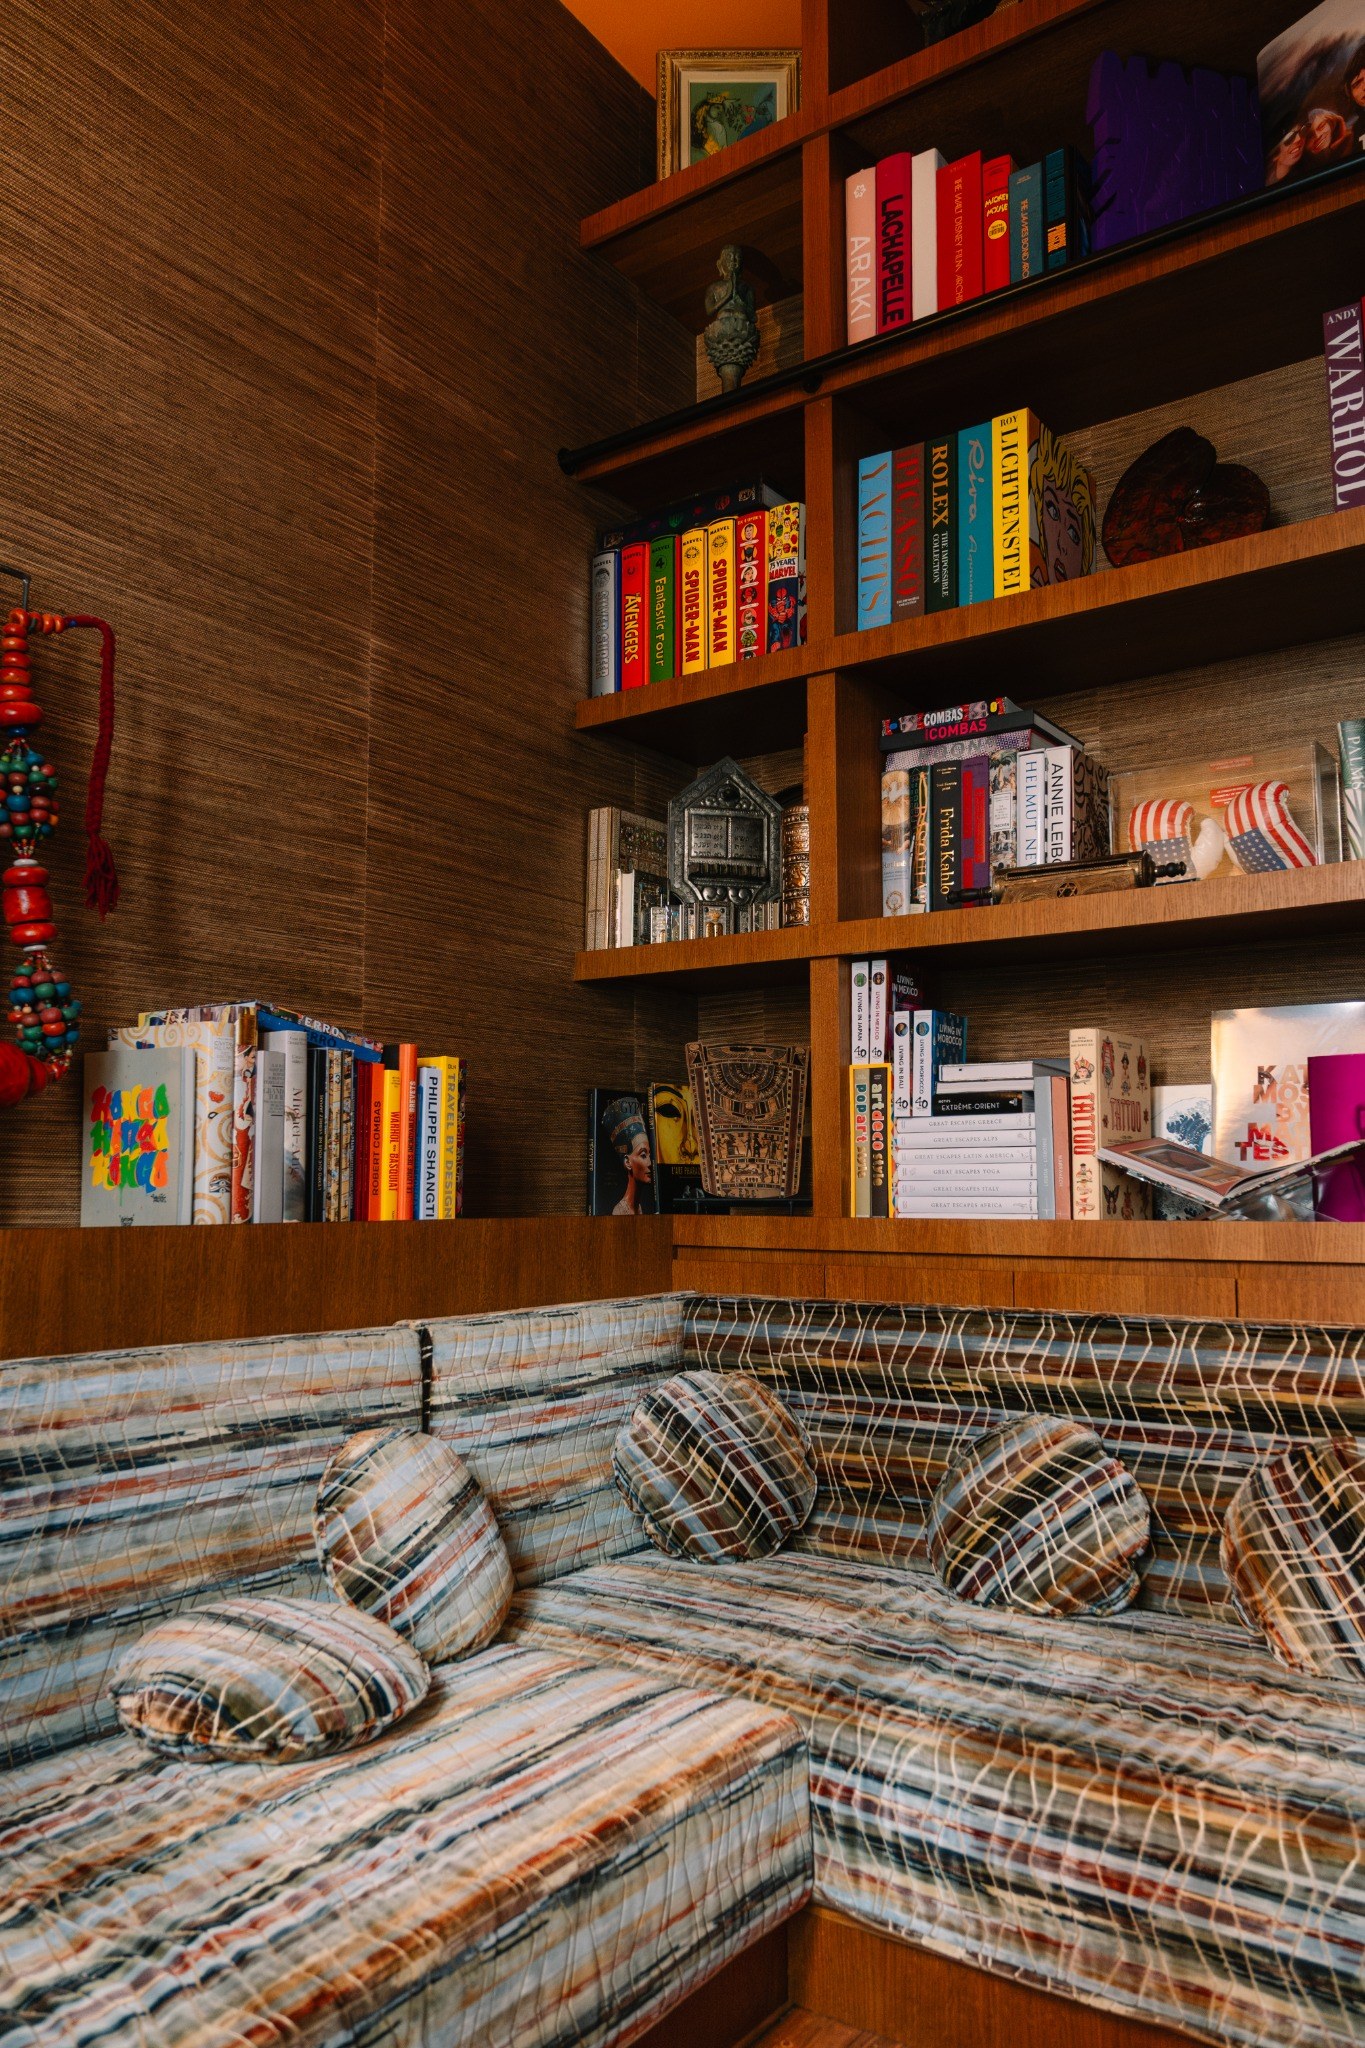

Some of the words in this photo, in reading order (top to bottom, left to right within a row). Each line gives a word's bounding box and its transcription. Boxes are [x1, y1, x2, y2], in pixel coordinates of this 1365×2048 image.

[954, 193, 963, 214] WALT
[984, 193, 1009, 208] MICKEY
[954, 215, 963, 247] DISNEY
[1021, 237, 1029, 261] BOND
[880, 193, 905, 328] LACHAPELLE
[850, 235, 871, 325] ARAKI
[1326, 306, 1360, 326] ANDY
[1000, 414, 1018, 427] ROY
[1326, 319, 1365, 506] WARHOL
[931, 443, 949, 529] ROLEX
[968, 438, 985, 524] Riva
[1000, 427, 1021, 593] LICHTENSTEI
[682, 537, 703, 547] MARVEL
[709, 525, 731, 536] MARVEL
[860, 461, 888, 612] YACHTS
[941, 530, 949, 548] THE
[654, 557, 665, 570] 4
[769, 560, 776, 571] 75
[776, 557, 796, 568] YEARS
[769, 566, 796, 580] MARVEL
[932, 533, 940, 584] COLLECTION
[941, 550, 949, 598] IMPOSSIBLE
[654, 576, 667, 631] Fantastic
[684, 569, 700, 663] SPIDER-MAN
[712, 558, 728, 654] SPIDER-MAN
[624, 592, 642, 665] AVENGERS
[923, 707, 964, 727] COMBAS
[1025, 760, 1037, 831] HELMUT
[1051, 763, 1064, 817] ANNIE
[940, 807, 954, 848] Frida
[940, 849, 955, 895] Kahlo
[892, 983, 898, 992] IN
[898, 985, 919, 997] MEXICO
[896, 974, 914, 986] LIVING
[937, 1033, 963, 1047] MOROCCO
[939, 1023, 955, 1037] LIVING
[853, 1046, 867, 1058] 40
[871, 1046, 883, 1058] 40
[1257, 1064, 1309, 1084] KAT
[409, 1080, 417, 1113] BREVETS
[427, 1075, 439, 1144] PHILIPPE
[446, 1073, 456, 1130] TRAVEL
[895, 1097, 909, 1109] 40
[915, 1096, 929, 1109] 40
[372, 1100, 381, 1149] COMBAS
[390, 1111, 401, 1144] WARHOL
[1072, 1092, 1096, 1156] TATTOO
[1109, 1097, 1142, 1133] TATTOO
[446, 1135, 454, 1155] BY
[371, 1151, 380, 1196] ROBERT
[388, 1153, 400, 1191] BASQUIAT
[425, 1149, 437, 1218] SHANGTI
[444, 1160, 454, 1219] DESIGN
